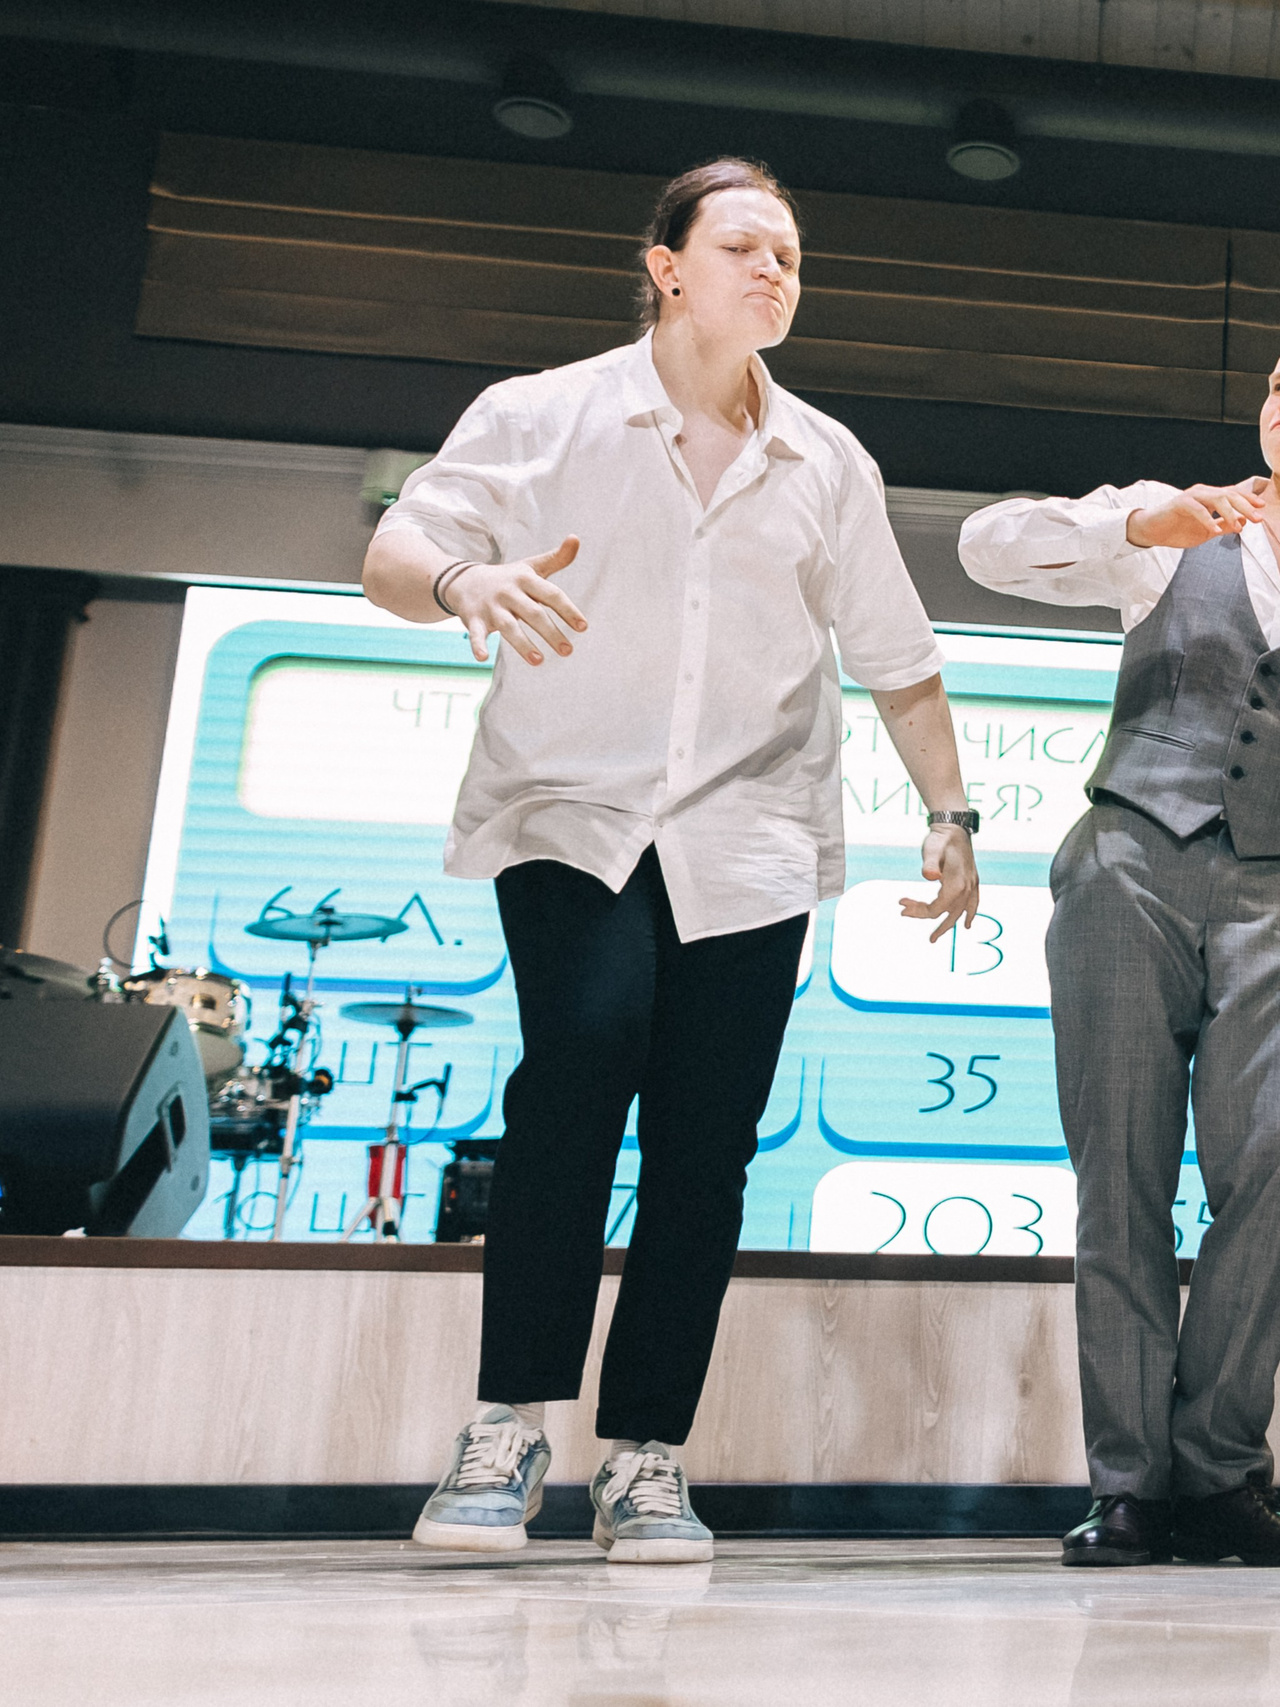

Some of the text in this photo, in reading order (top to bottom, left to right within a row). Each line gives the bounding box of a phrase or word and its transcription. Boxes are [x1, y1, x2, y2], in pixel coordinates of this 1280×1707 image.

[392, 687, 1107, 764] ЧТ ЧИСЛ
[918, 1051, 1001, 1114] 35
[869, 1190, 1044, 1256] 203
